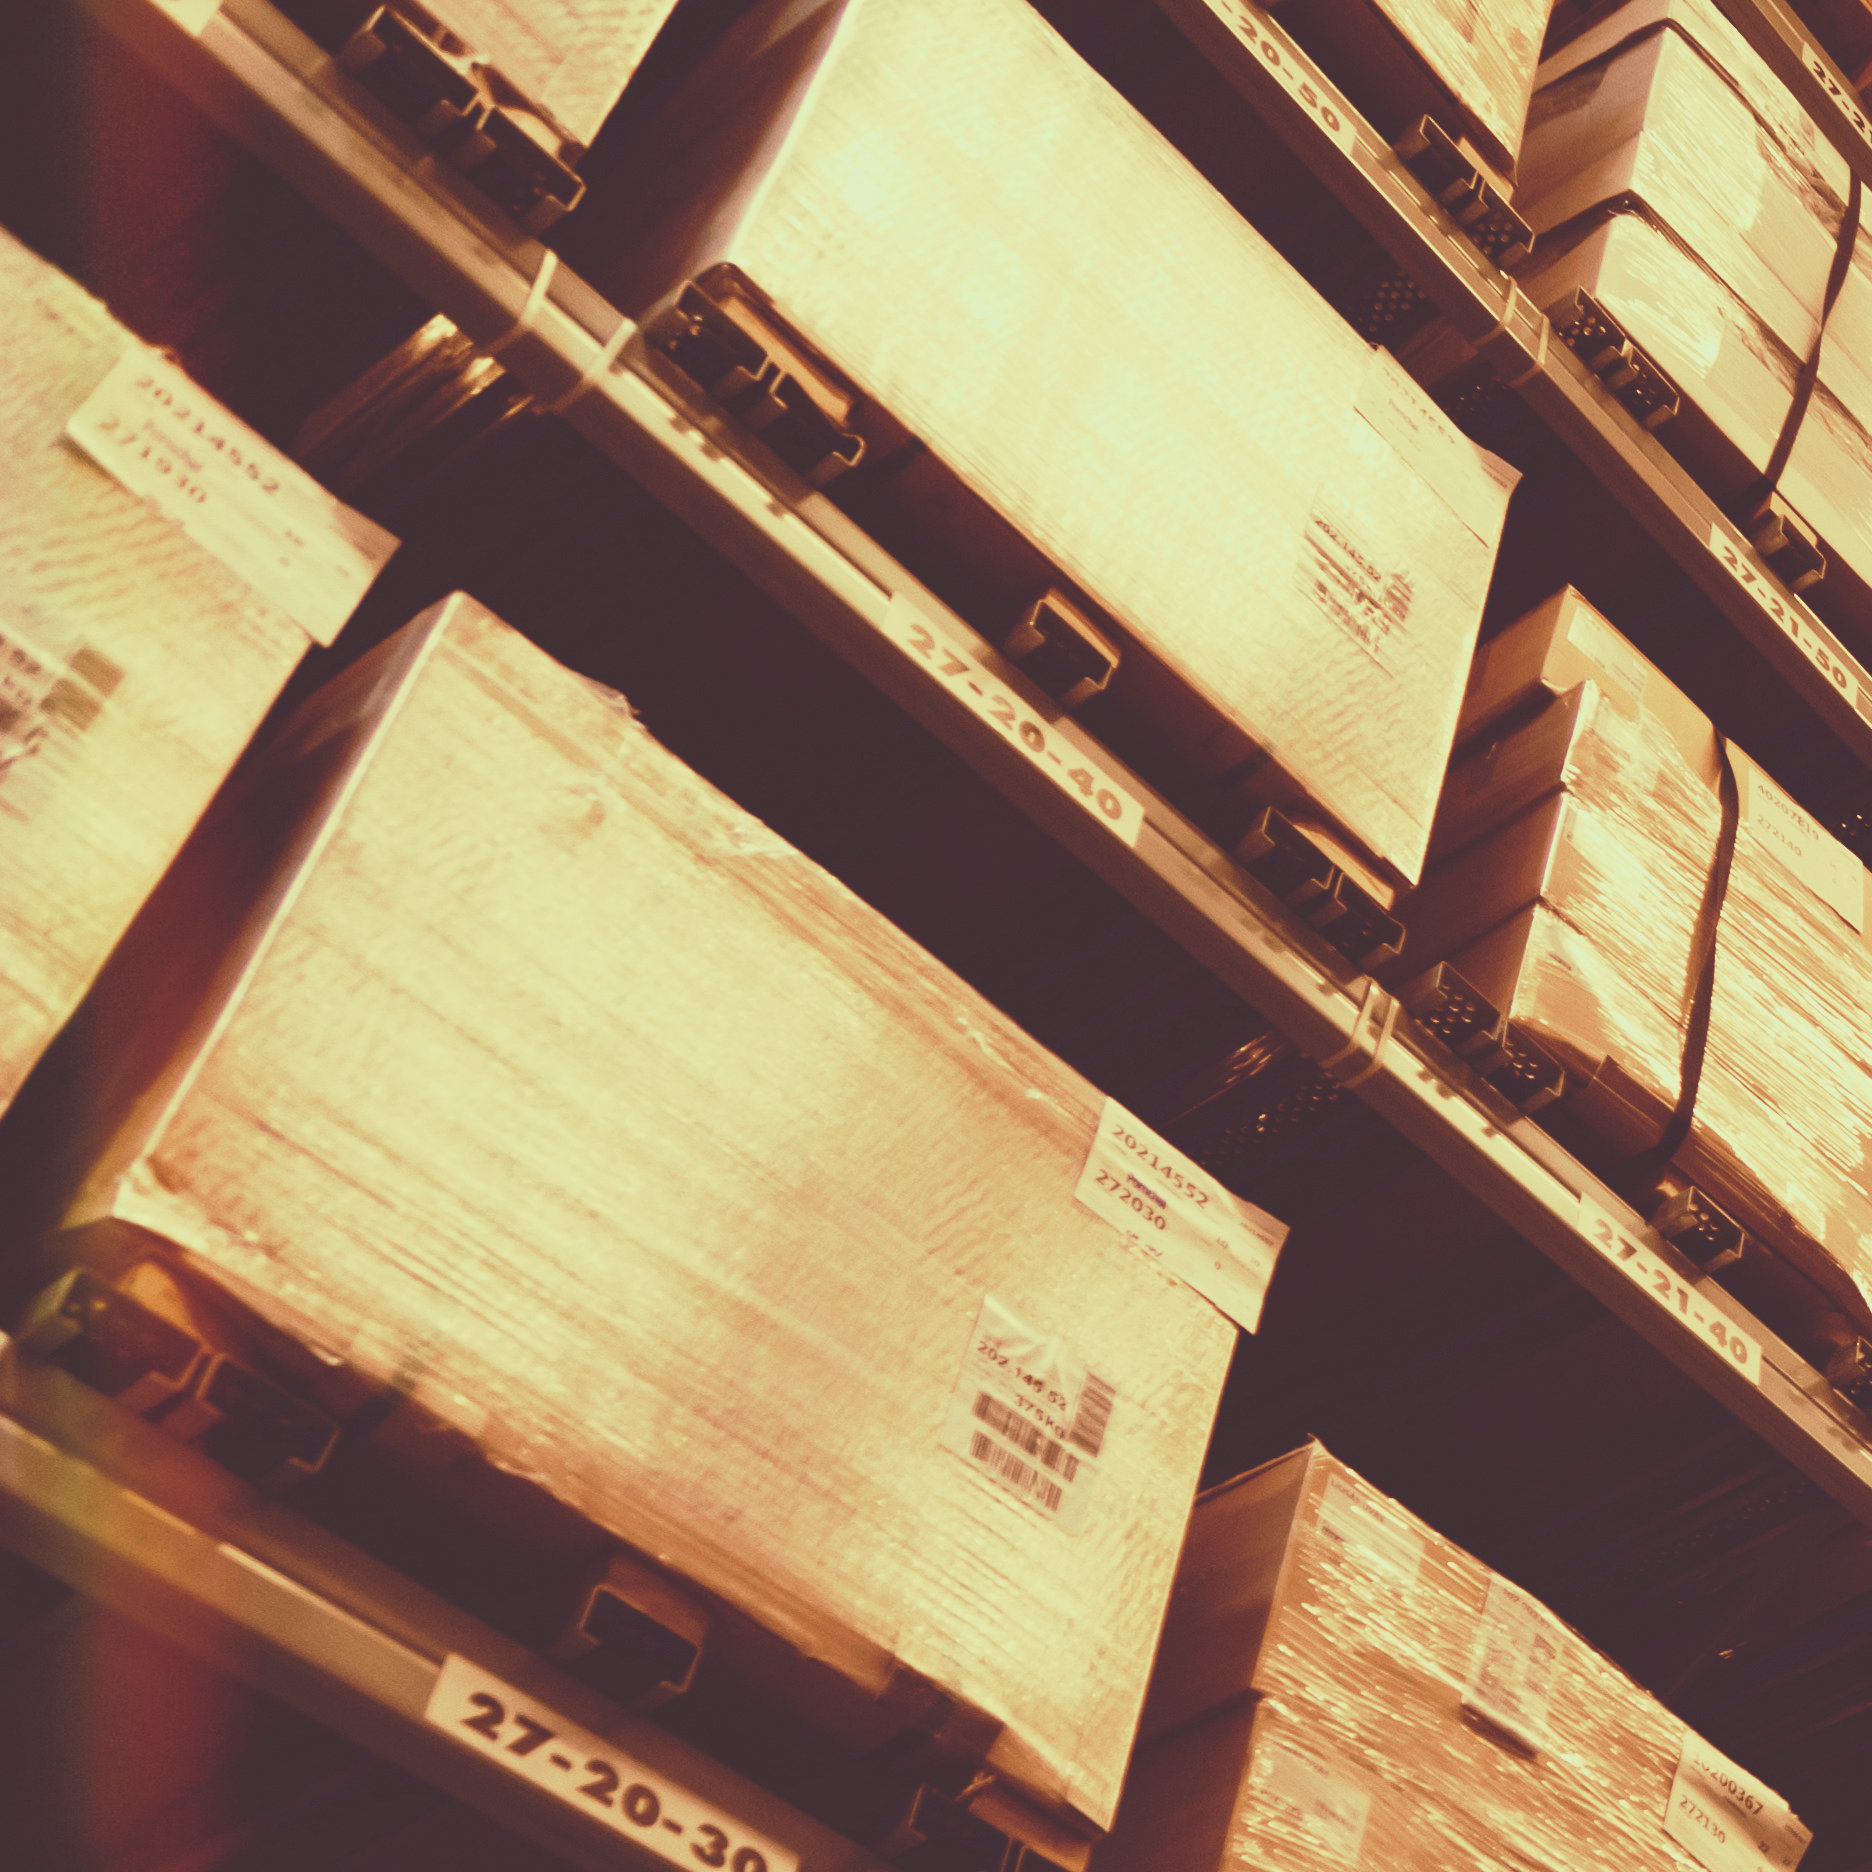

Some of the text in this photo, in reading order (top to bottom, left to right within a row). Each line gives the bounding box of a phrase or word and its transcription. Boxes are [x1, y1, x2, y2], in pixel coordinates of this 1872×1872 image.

[1721, 543, 1848, 690] 27-21-50
[905, 622, 1123, 820] 27-20-40
[1095, 1168, 1167, 1231] 272030
[1111, 1123, 1210, 1209] 20214552
[1592, 1218, 1748, 1366] 27-21-40
[1680, 1793, 1726, 1844] 272130
